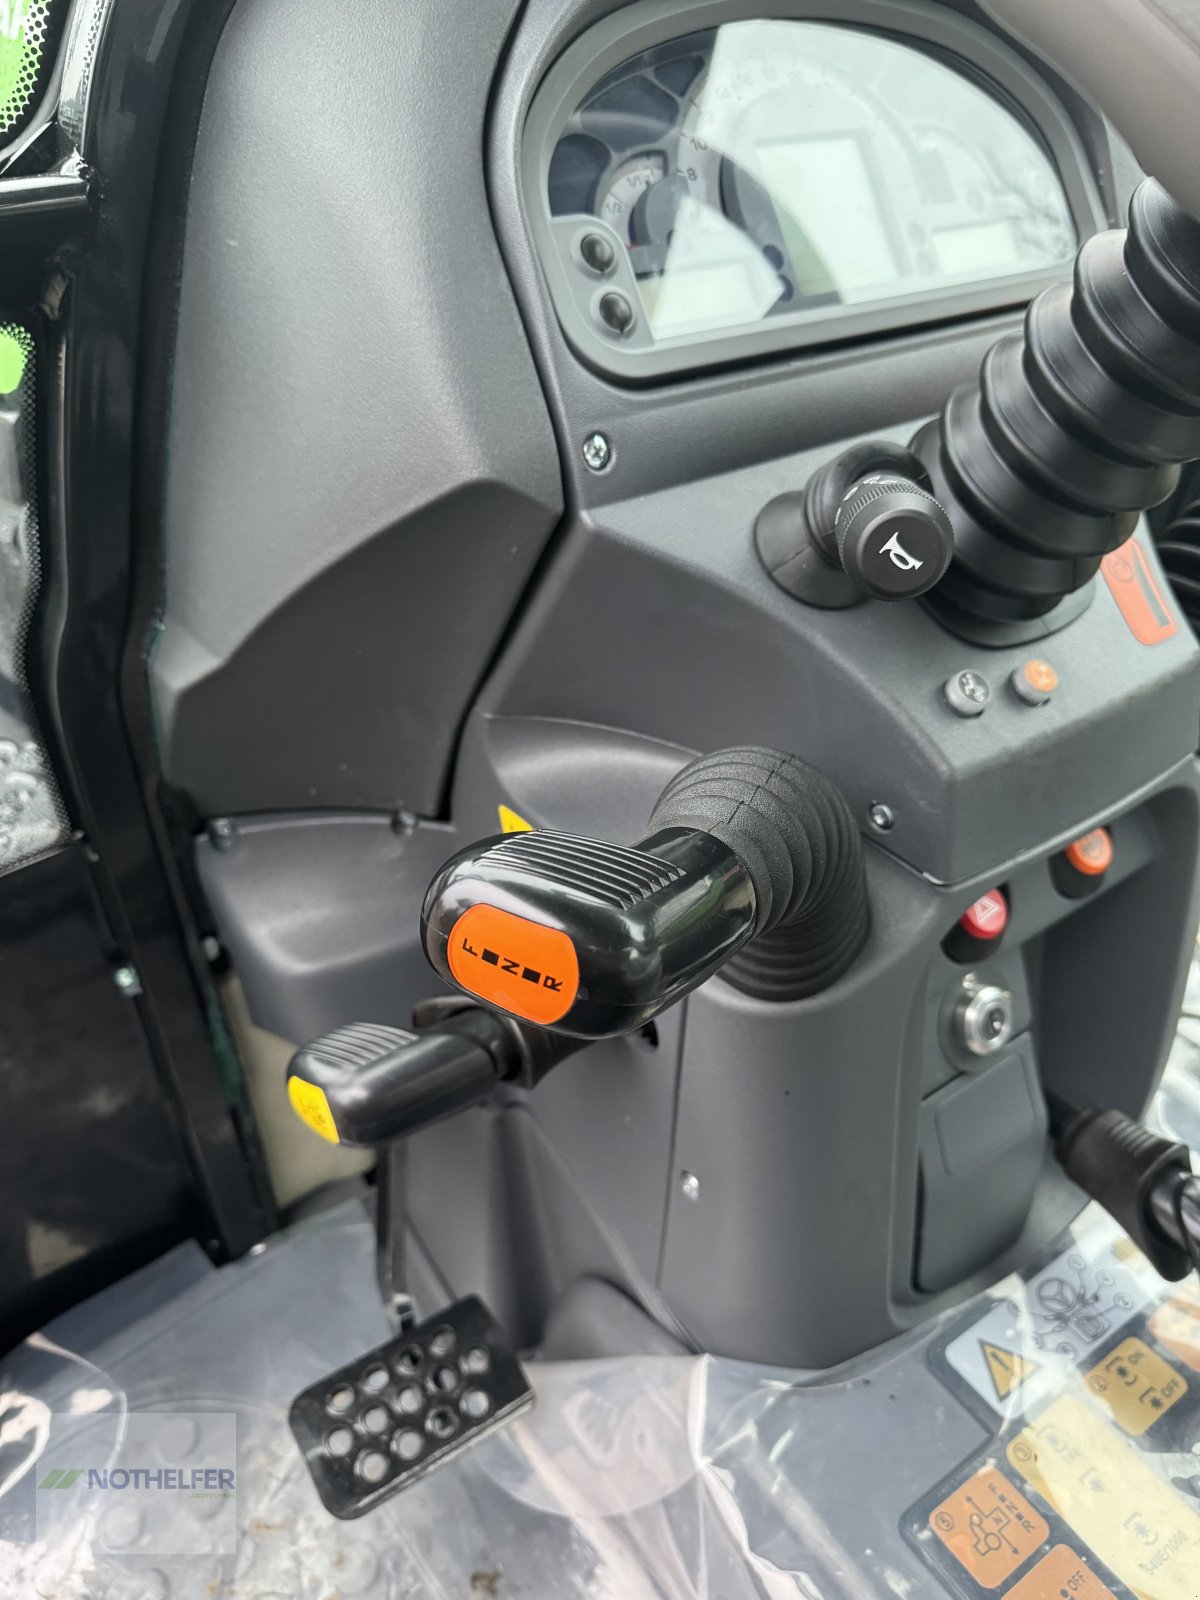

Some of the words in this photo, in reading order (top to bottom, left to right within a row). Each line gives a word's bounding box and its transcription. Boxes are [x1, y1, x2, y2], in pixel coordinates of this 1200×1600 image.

[690, 138, 708, 152] 10
[687, 168, 697, 181] 8
[606, 203, 624, 216] 1/2
[1161, 1378, 1180, 1398] OFF
[1067, 1570, 1086, 1591] OFF
